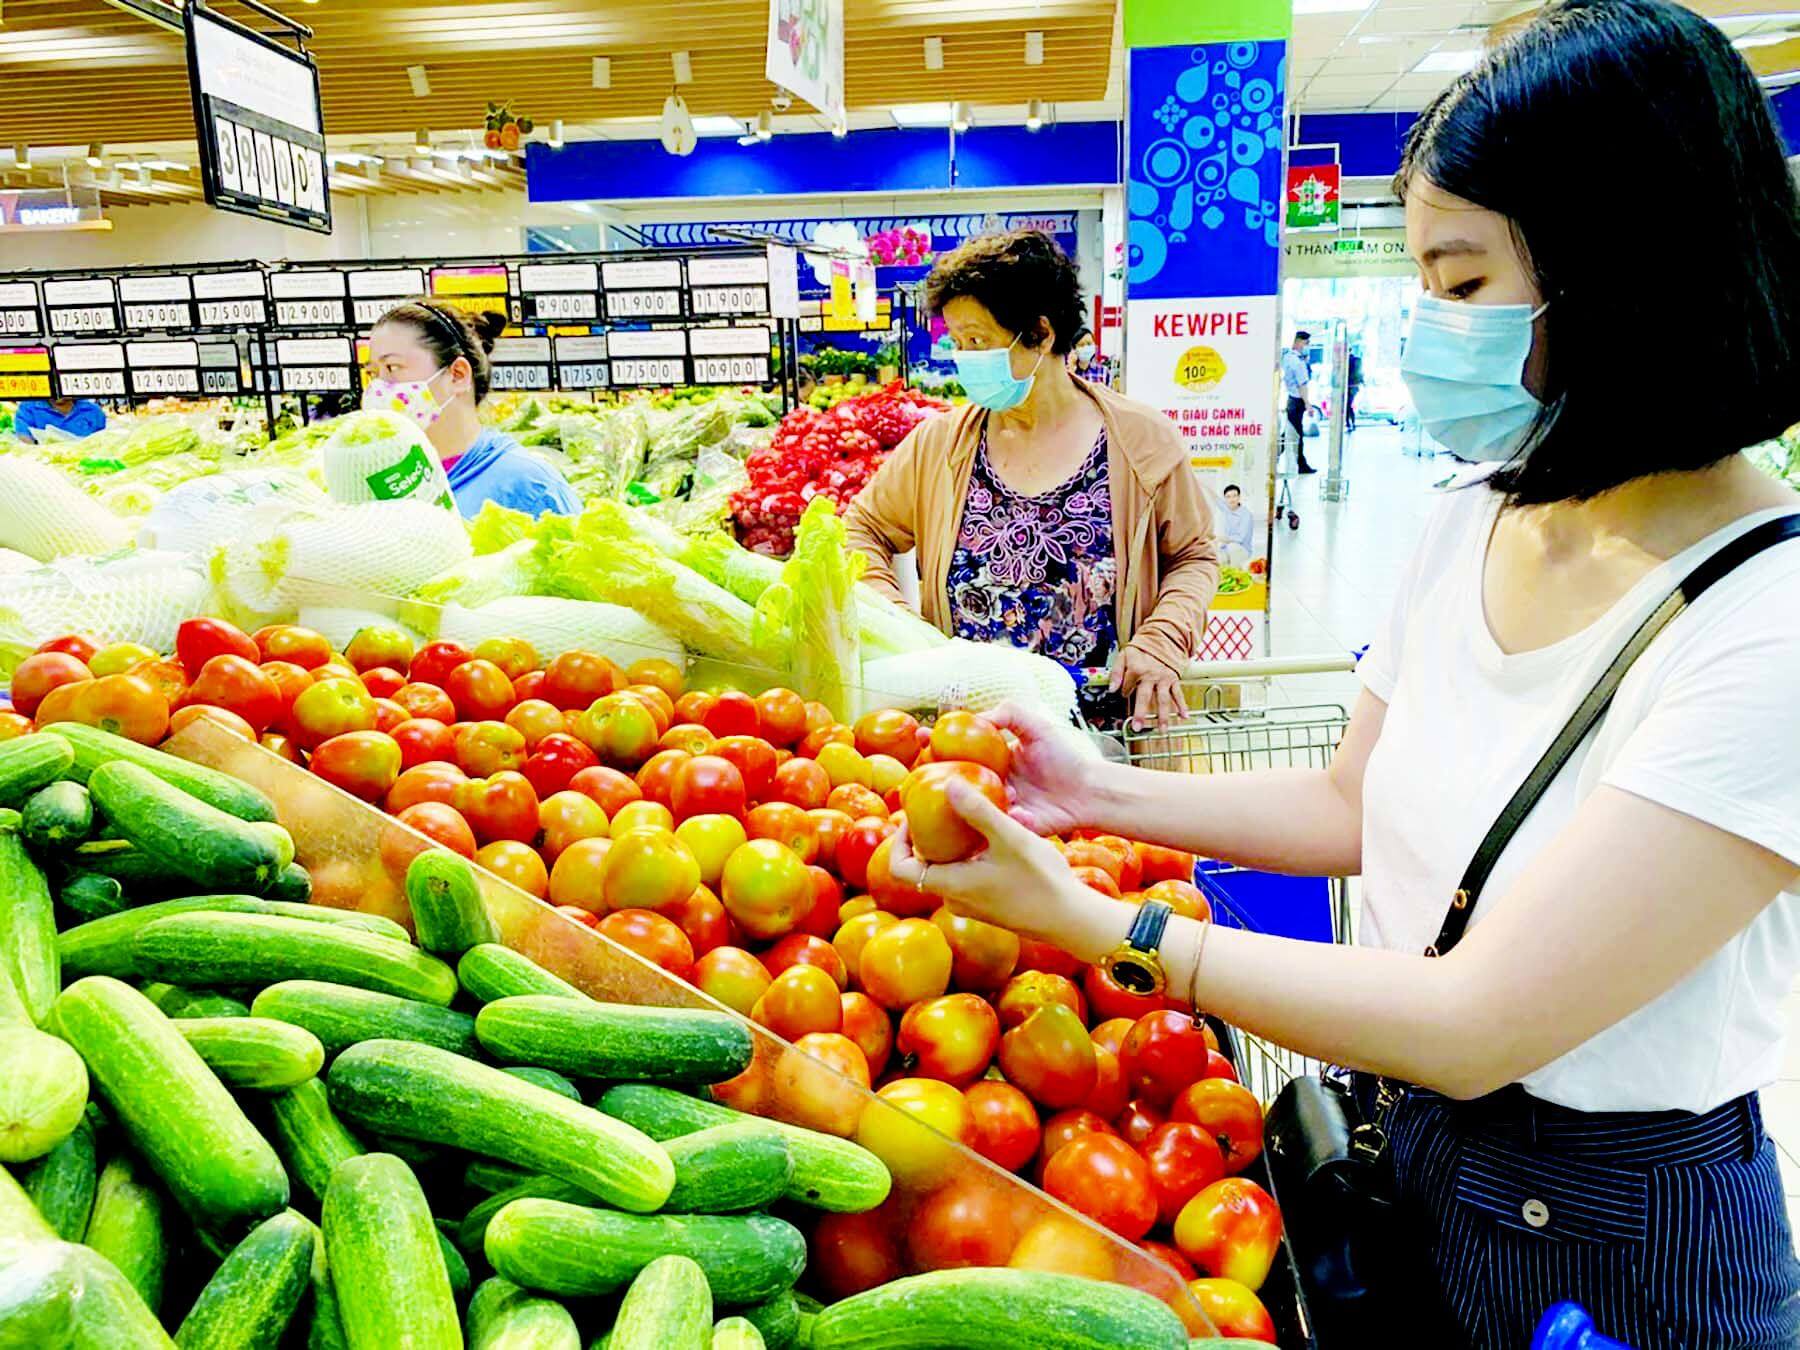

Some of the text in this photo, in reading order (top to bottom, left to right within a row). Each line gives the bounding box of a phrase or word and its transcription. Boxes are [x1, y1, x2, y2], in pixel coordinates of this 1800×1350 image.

[20, 207, 79, 225] BAKERY
[1154, 311, 1249, 338] KEWPIE
[1184, 365, 1206, 380] 100
